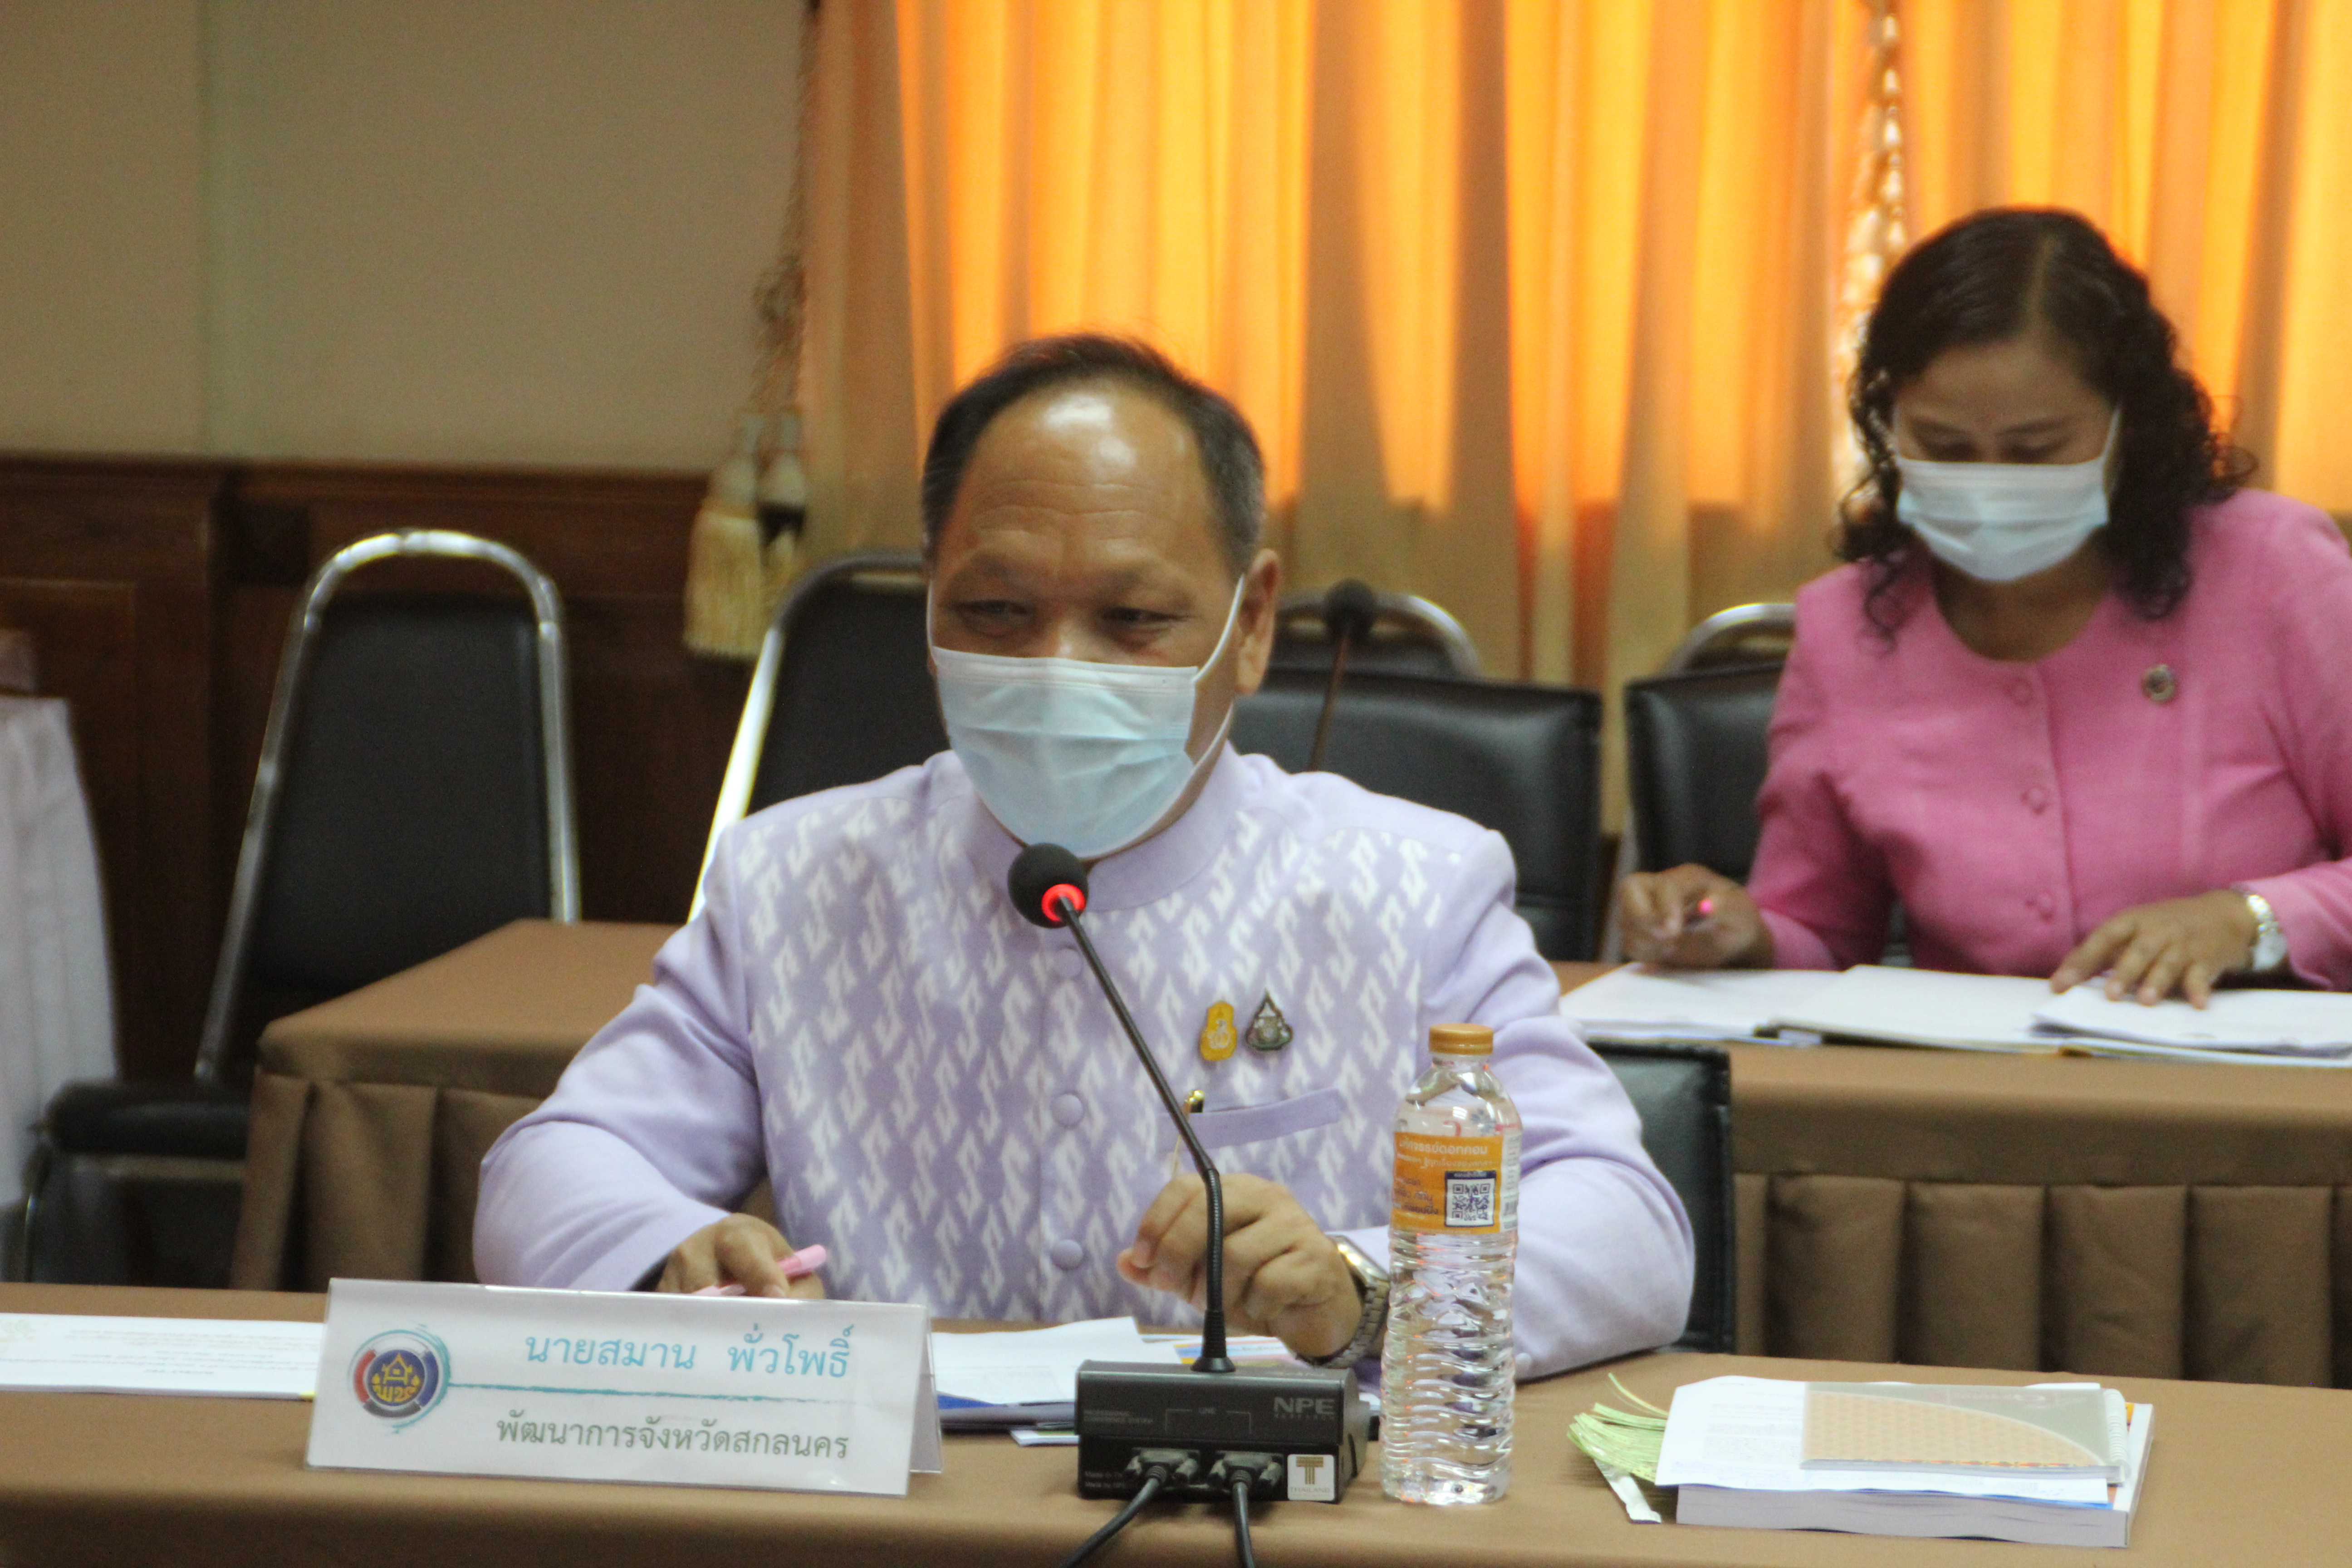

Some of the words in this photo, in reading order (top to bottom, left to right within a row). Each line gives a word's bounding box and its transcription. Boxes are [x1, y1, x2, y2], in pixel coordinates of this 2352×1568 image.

[525, 1335, 696, 1369] นายสมาน
[727, 1322, 855, 1378] พั่วโพธิ์
[1274, 1396, 1335, 1414] NPE
[496, 1408, 849, 1459] พัฒนาการจังหวัดสกลนคร
